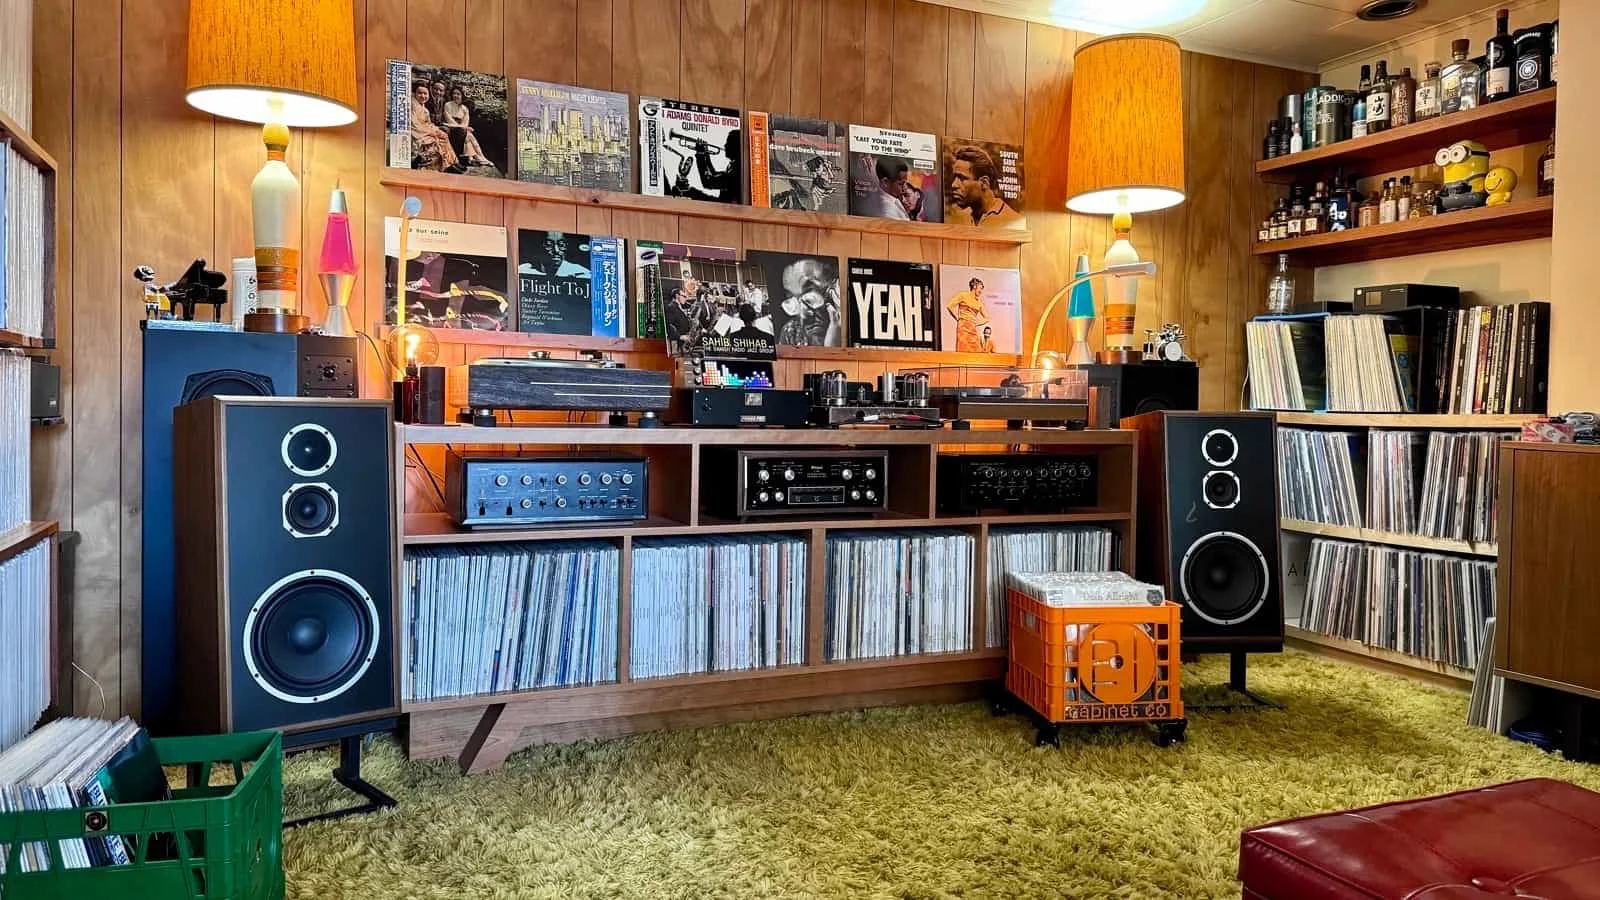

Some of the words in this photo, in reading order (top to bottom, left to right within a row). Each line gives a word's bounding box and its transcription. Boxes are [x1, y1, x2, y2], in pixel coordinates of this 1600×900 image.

[667, 110, 692, 122] ADAMS
[694, 114, 720, 125] DONALD
[721, 118, 739, 128] BYRD
[682, 122, 708, 132] QUINTET
[1000, 150, 1019, 159] SOUTH
[520, 279, 561, 296] Flight
[563, 281, 584, 296] To
[702, 336, 730, 347] SAHIB
[733, 338, 768, 349] SHIHAB
